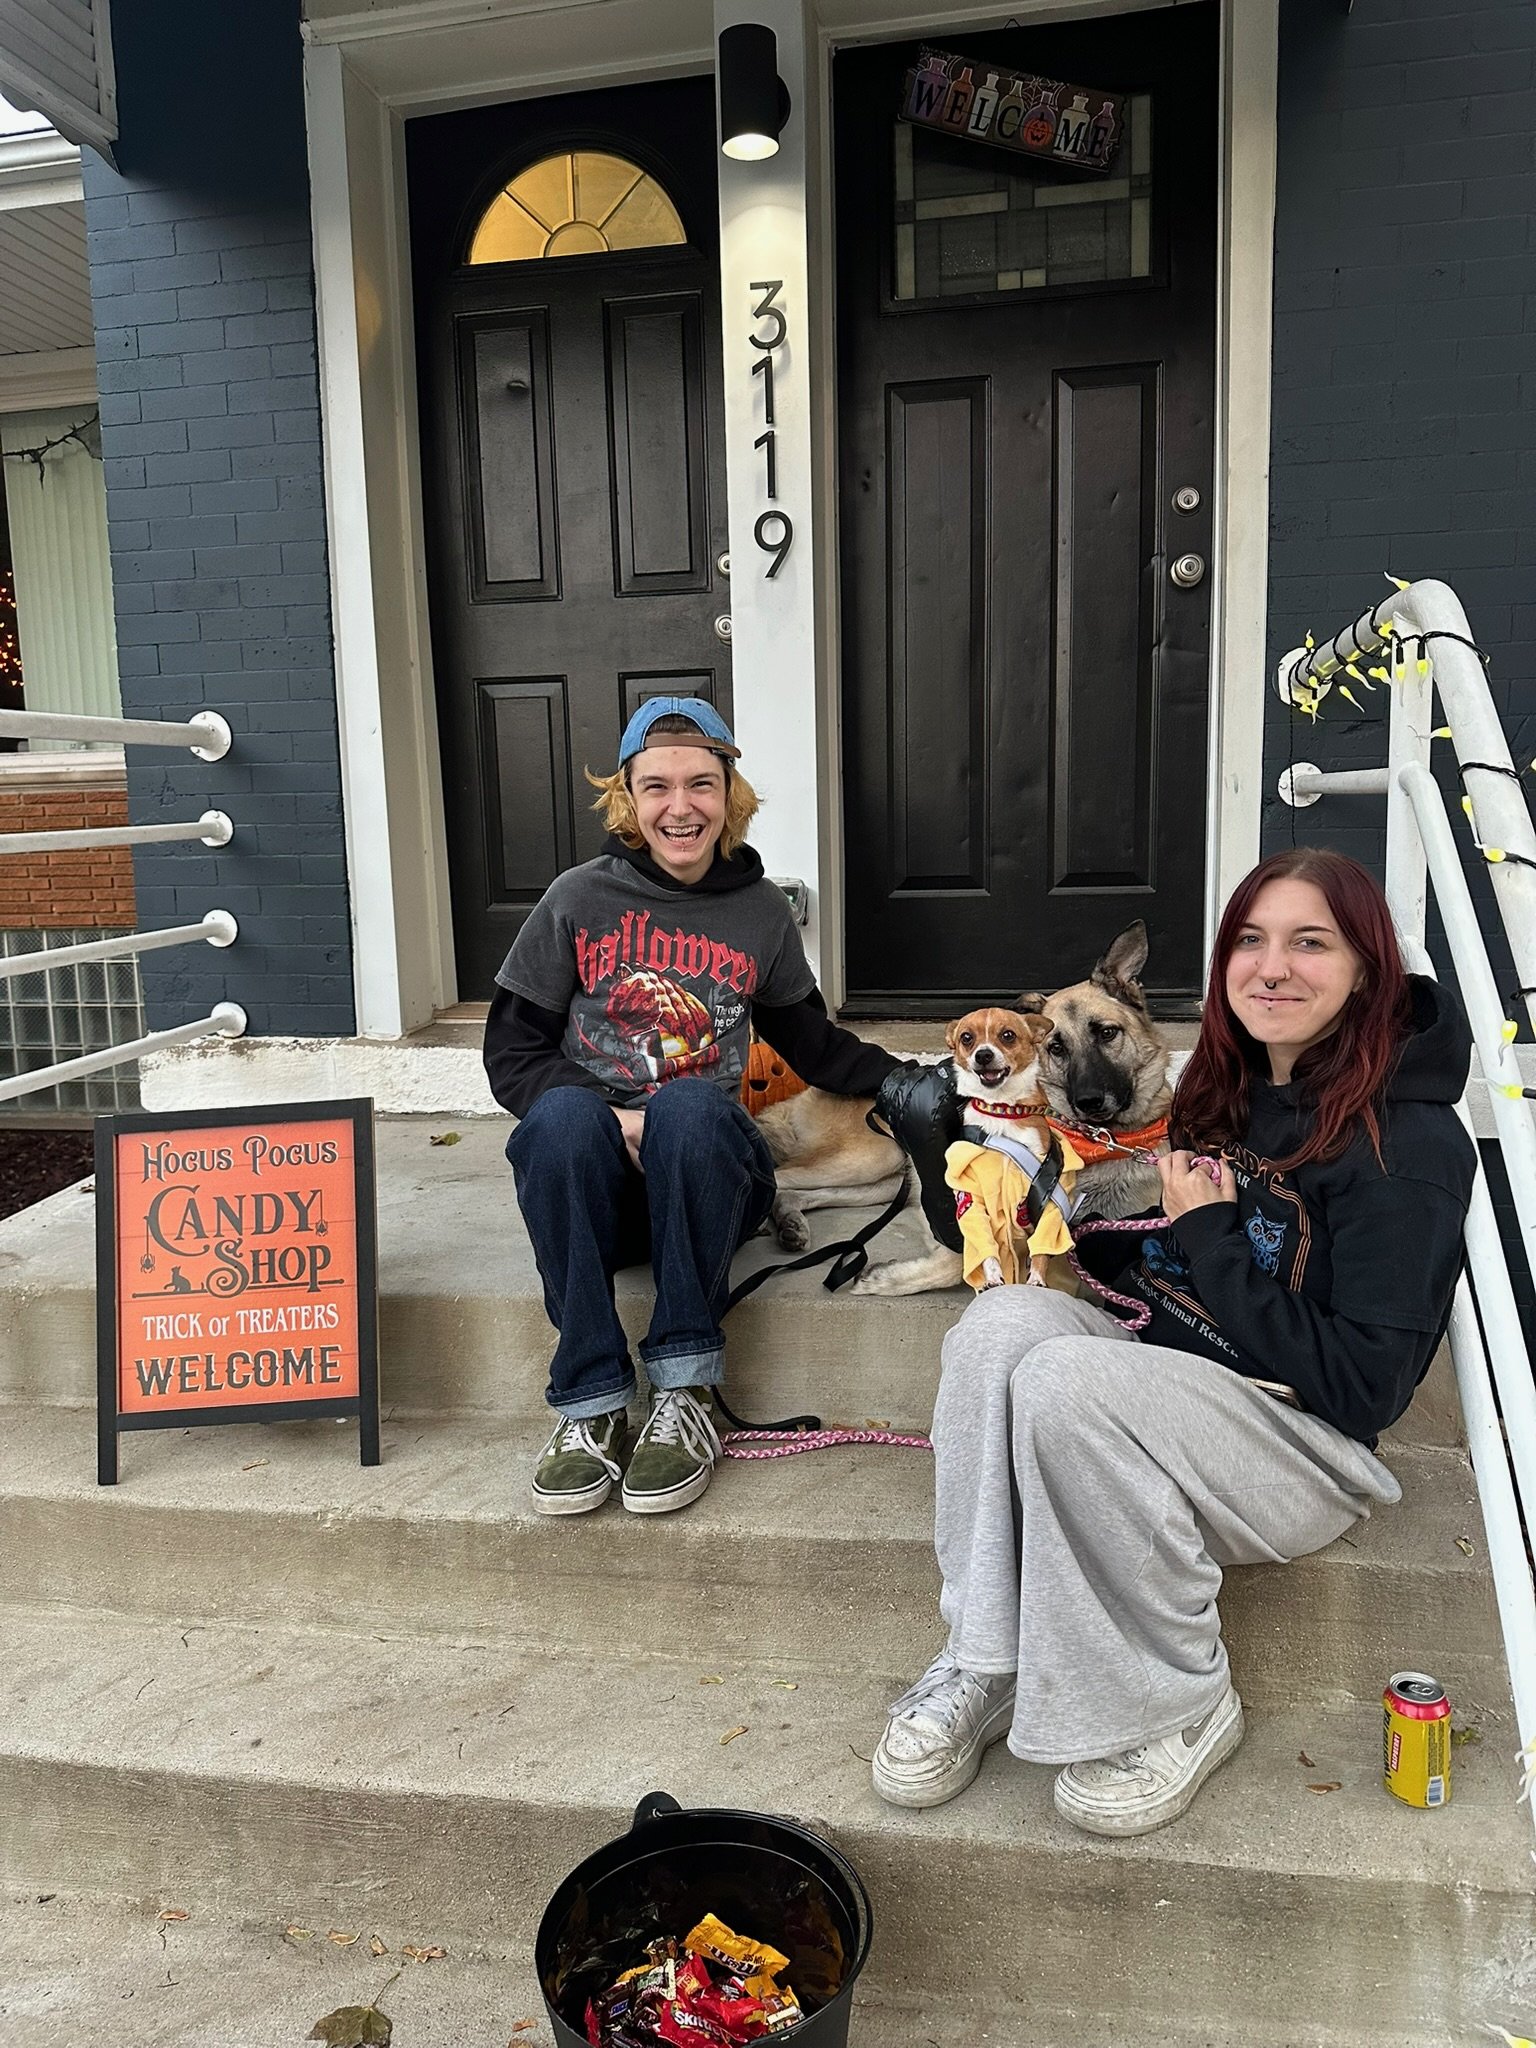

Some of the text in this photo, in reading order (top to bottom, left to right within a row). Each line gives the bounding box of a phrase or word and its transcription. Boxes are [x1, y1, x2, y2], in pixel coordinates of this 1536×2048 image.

[749, 280, 794, 579] 3119
[728, 1003, 744, 1017] nigh
[148, 1184, 321, 1257] CANDY
[206, 1238, 331, 1299] SHOP
[142, 1303, 340, 1341] TRICK or TREATERS
[1160, 1296, 1196, 1329] Animal
[1199, 1322, 1239, 1358] Resc
[134, 1345, 343, 1396] WELCOME
[674, 2010, 722, 2036] Skittl
